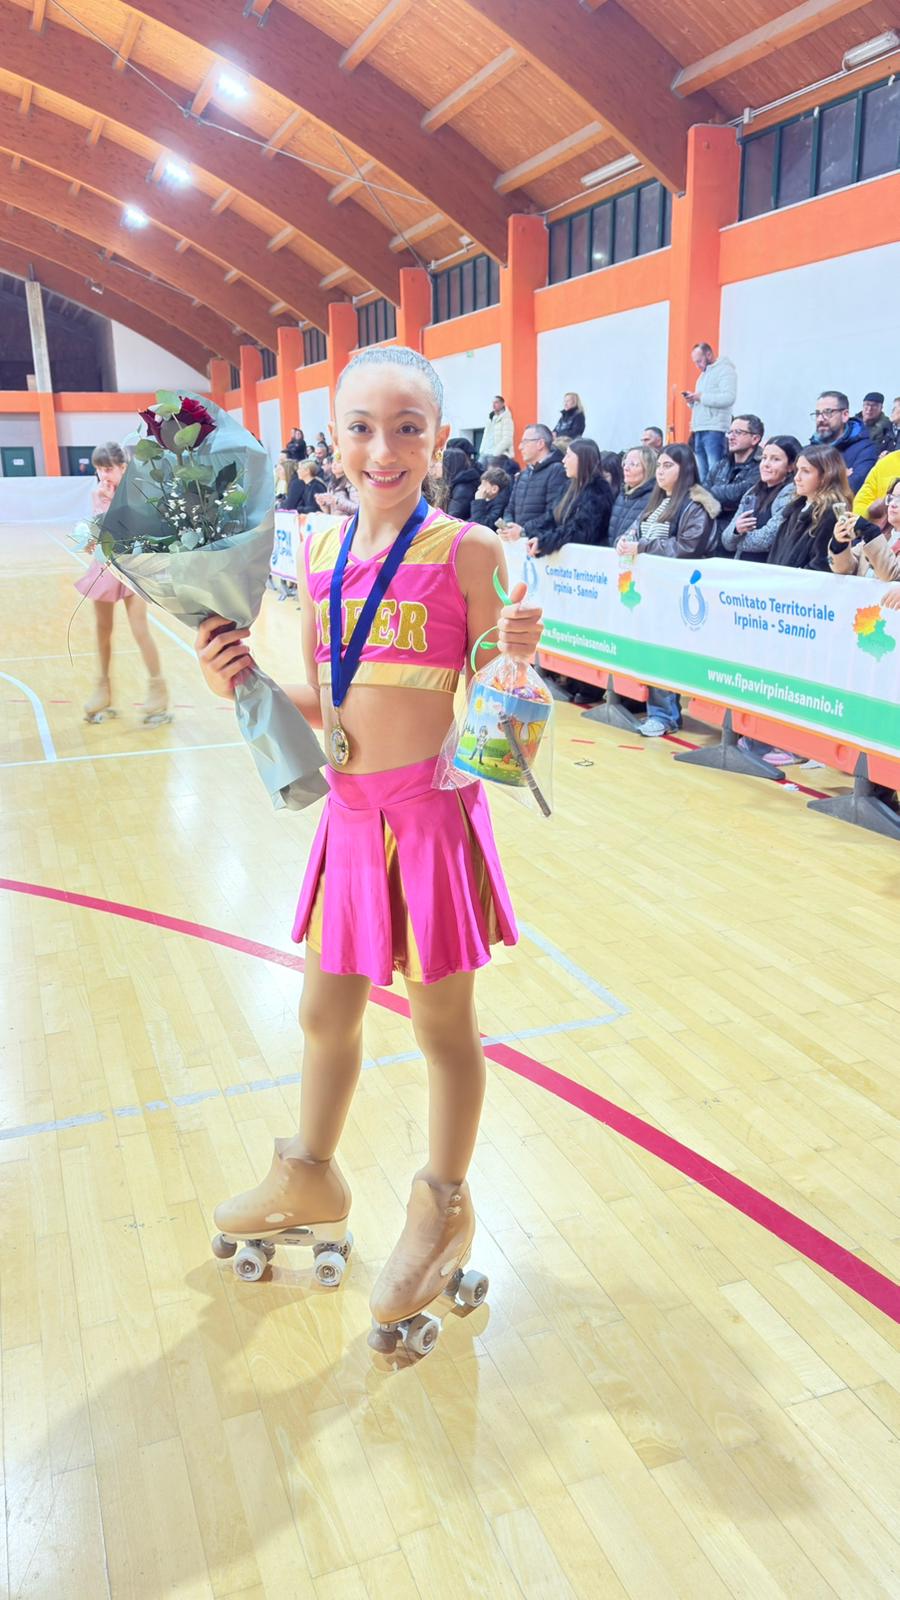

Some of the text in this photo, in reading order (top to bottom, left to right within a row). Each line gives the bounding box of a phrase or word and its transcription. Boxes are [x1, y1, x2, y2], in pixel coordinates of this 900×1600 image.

[545, 565, 608, 584] Comitato Territoriale
[554, 580, 573, 595] Irpinia
[577, 585, 599, 599] Sannio
[719, 591, 835, 622] Comitato Territoriale
[734, 612, 769, 630] Irpinia
[778, 619, 817, 640] Sannio
[707, 669, 844, 717] www.fipavirpiniasannio.it
